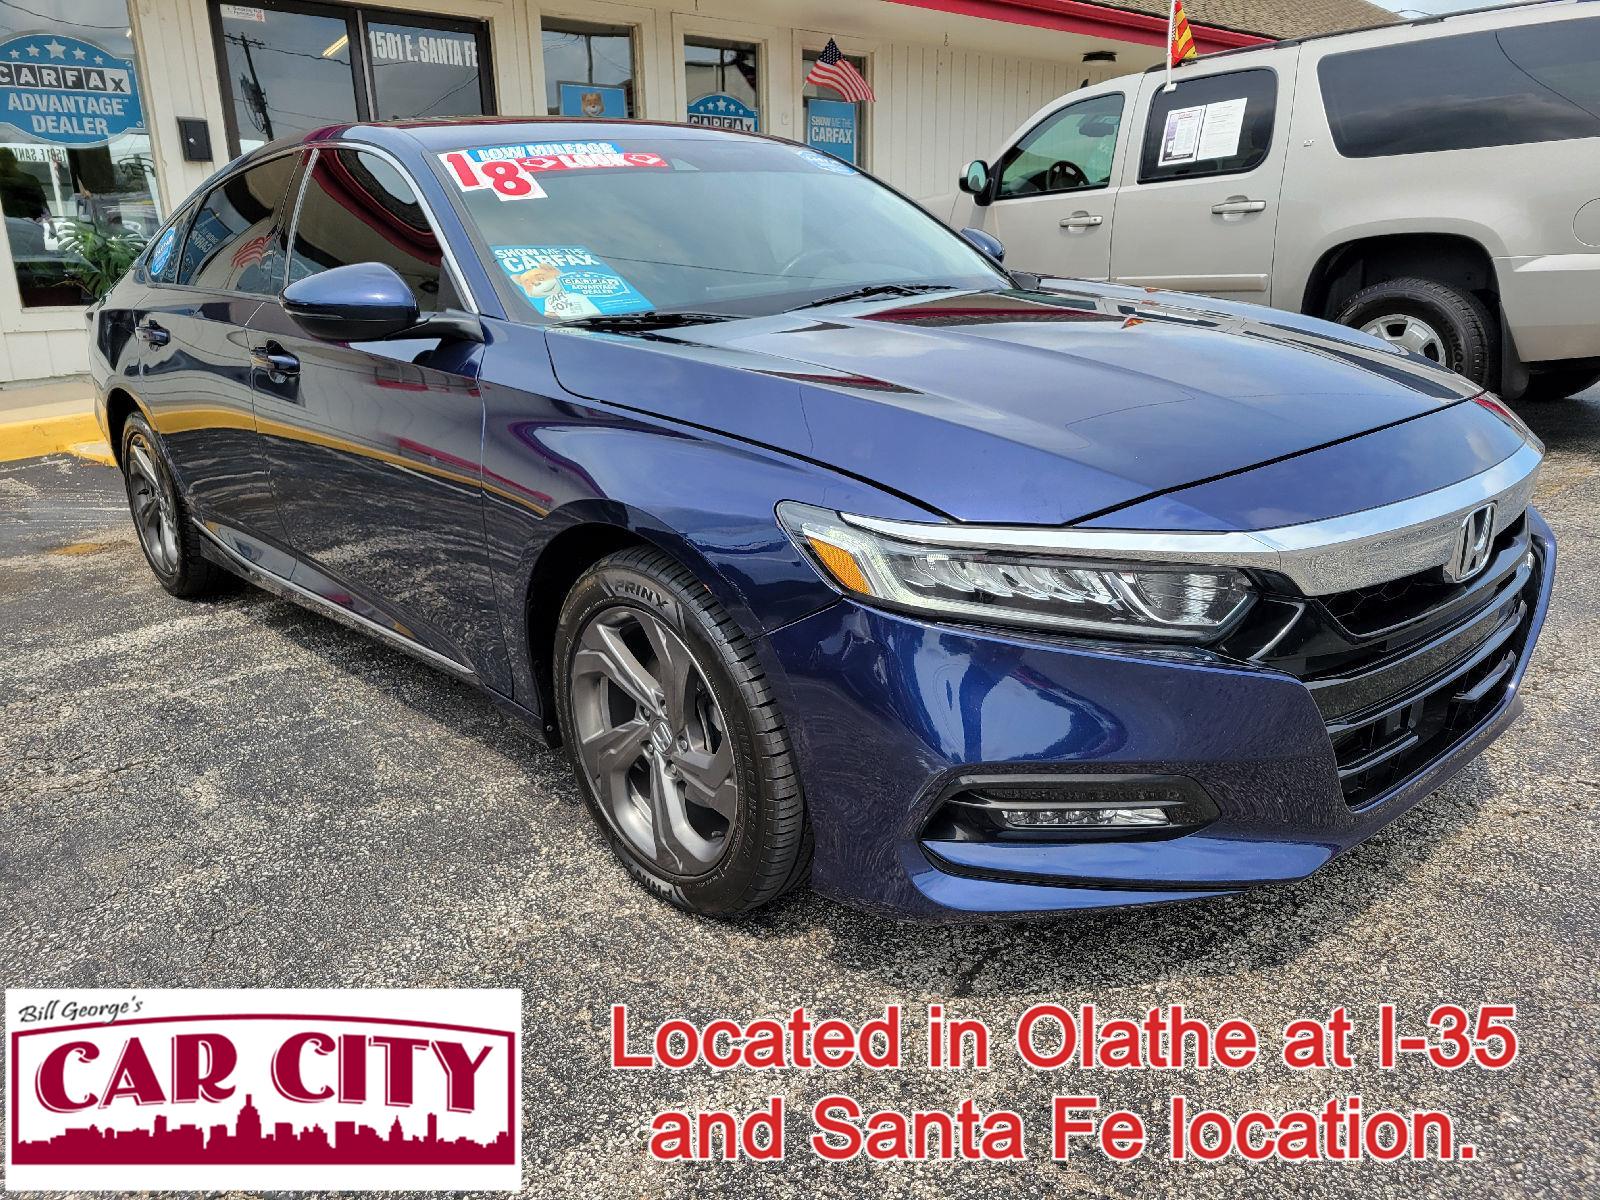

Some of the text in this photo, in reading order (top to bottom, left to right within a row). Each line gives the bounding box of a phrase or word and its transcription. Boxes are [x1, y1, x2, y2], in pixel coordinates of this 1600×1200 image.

[369, 30, 479, 67] 1501 E. SANTA FE
[0, 64, 125, 92] CARFAX
[8, 92, 126, 116] ADVANTAGE
[31, 114, 109, 136] DEALER
[811, 115, 853, 129] SHOW ME THE
[811, 126, 853, 144] CARFAX
[477, 142, 615, 162] LOW MILEAGE
[560, 153, 634, 169] LOOK
[494, 248, 586, 259] SHOW ME THE
[503, 255, 601, 273] CARFAX
[614, 579, 669, 610] PRINX
